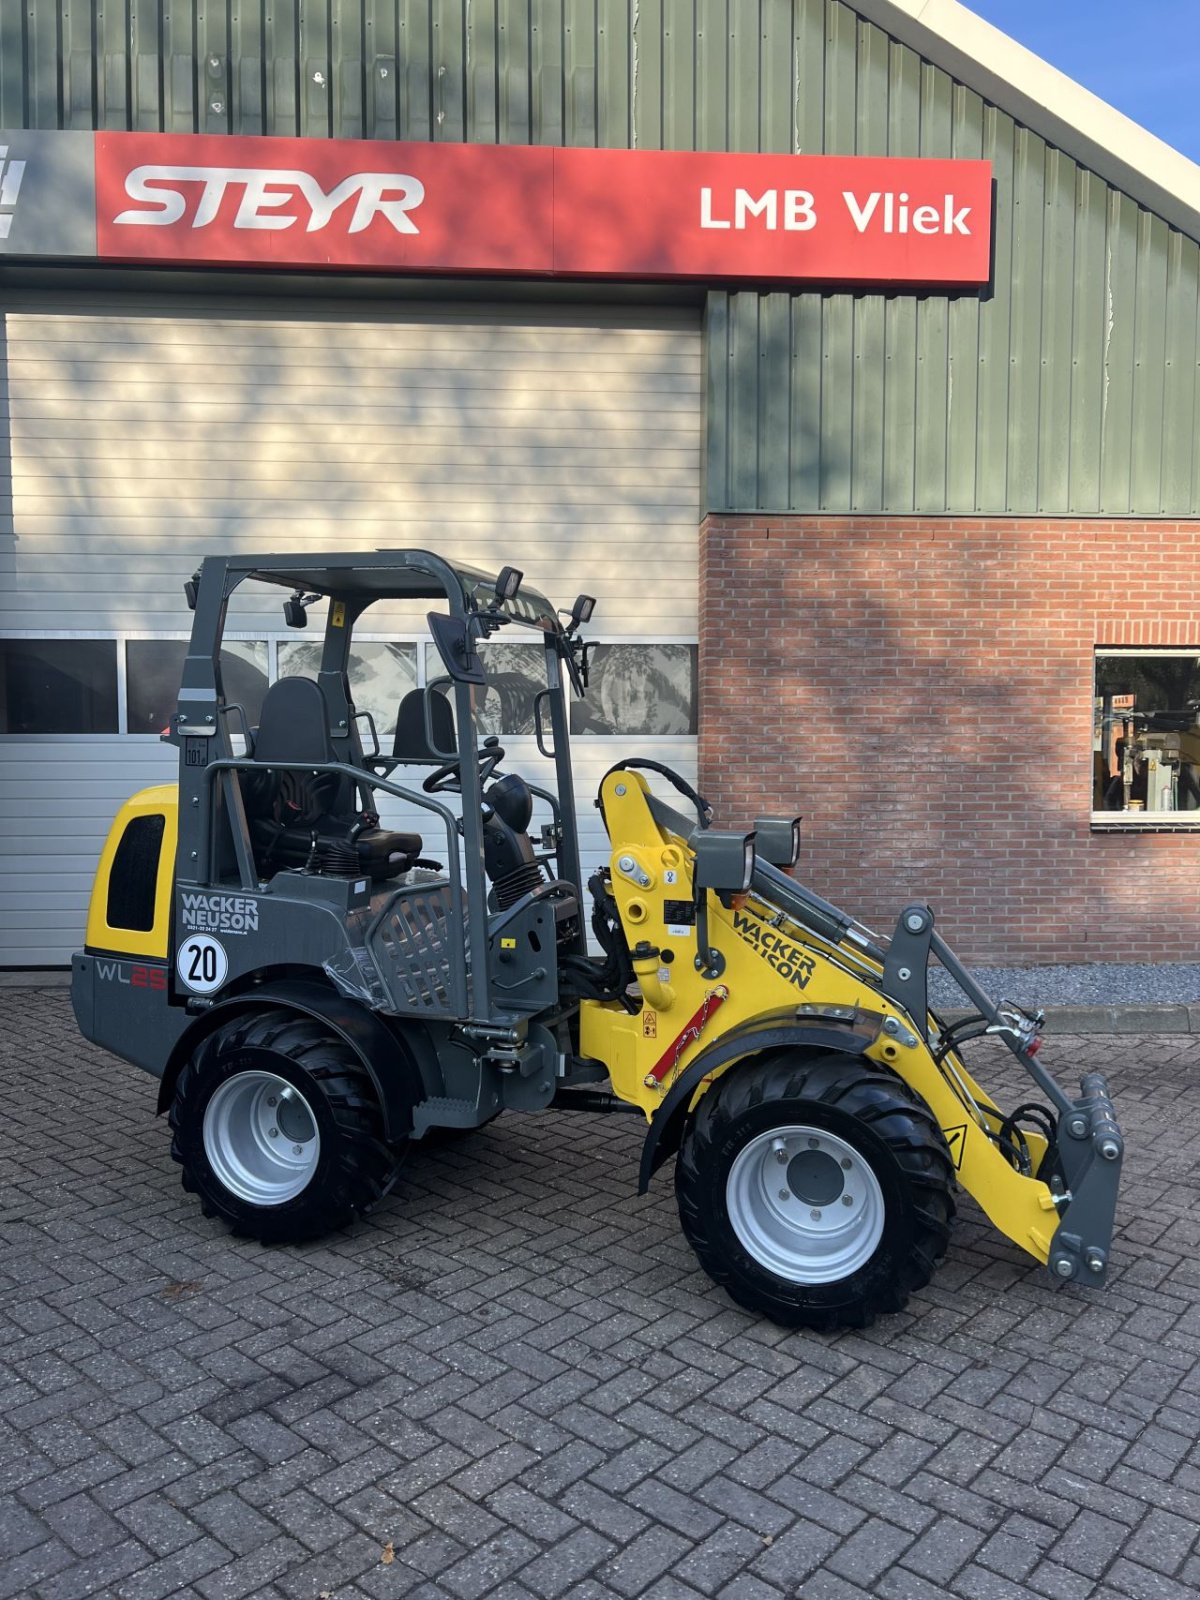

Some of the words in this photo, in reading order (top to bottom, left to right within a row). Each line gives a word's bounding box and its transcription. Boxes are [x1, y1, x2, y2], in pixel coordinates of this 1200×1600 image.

[112, 165, 425, 234] STEYR
[700, 187, 817, 231] LMB
[842, 191, 972, 235] Vliek
[181, 893, 259, 915] WACKER
[182, 909, 259, 931] NEUSON
[733, 911, 817, 976] WACKER
[96, 961, 169, 990] WL25
[188, 944, 217, 982] 20
